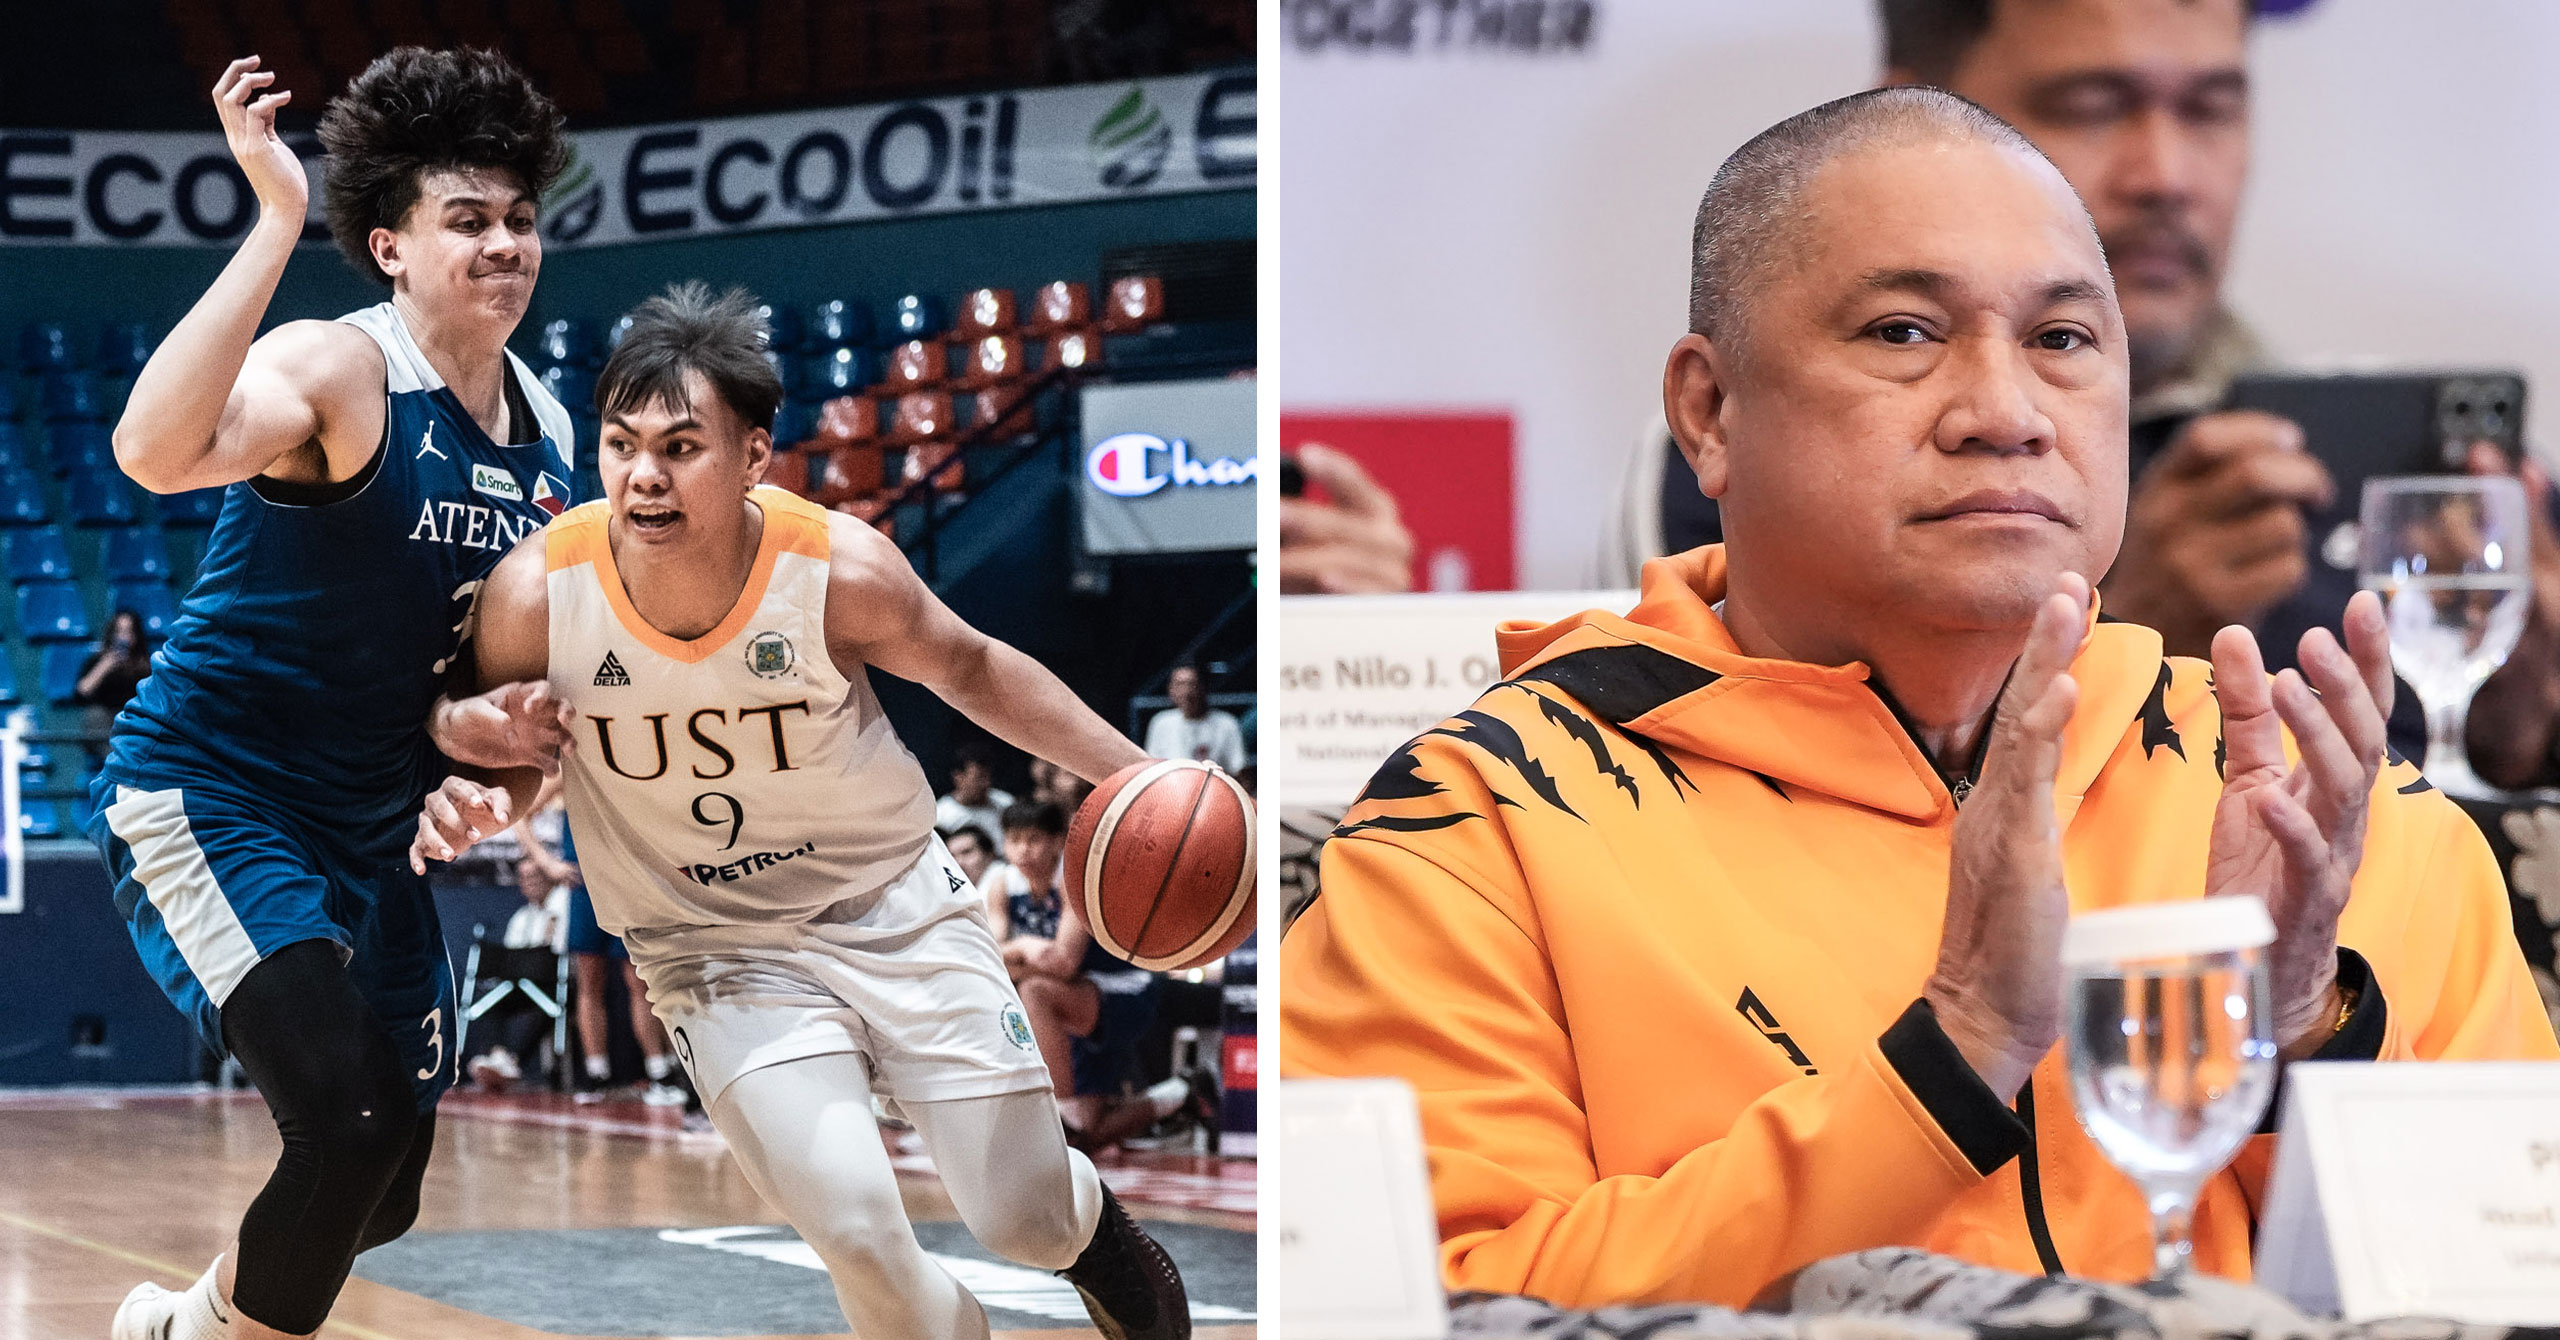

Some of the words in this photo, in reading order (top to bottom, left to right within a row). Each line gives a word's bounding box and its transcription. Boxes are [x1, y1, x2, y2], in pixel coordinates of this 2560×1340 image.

[487, 475, 521, 496] Smart
[593, 677, 631, 687] DELTA
[1335, 655, 1411, 689] Nilo
[586, 700, 811, 781] UST
[691, 792, 743, 851] 9
[418, 1007, 443, 1080] 3
[674, 1026, 697, 1088] 9
